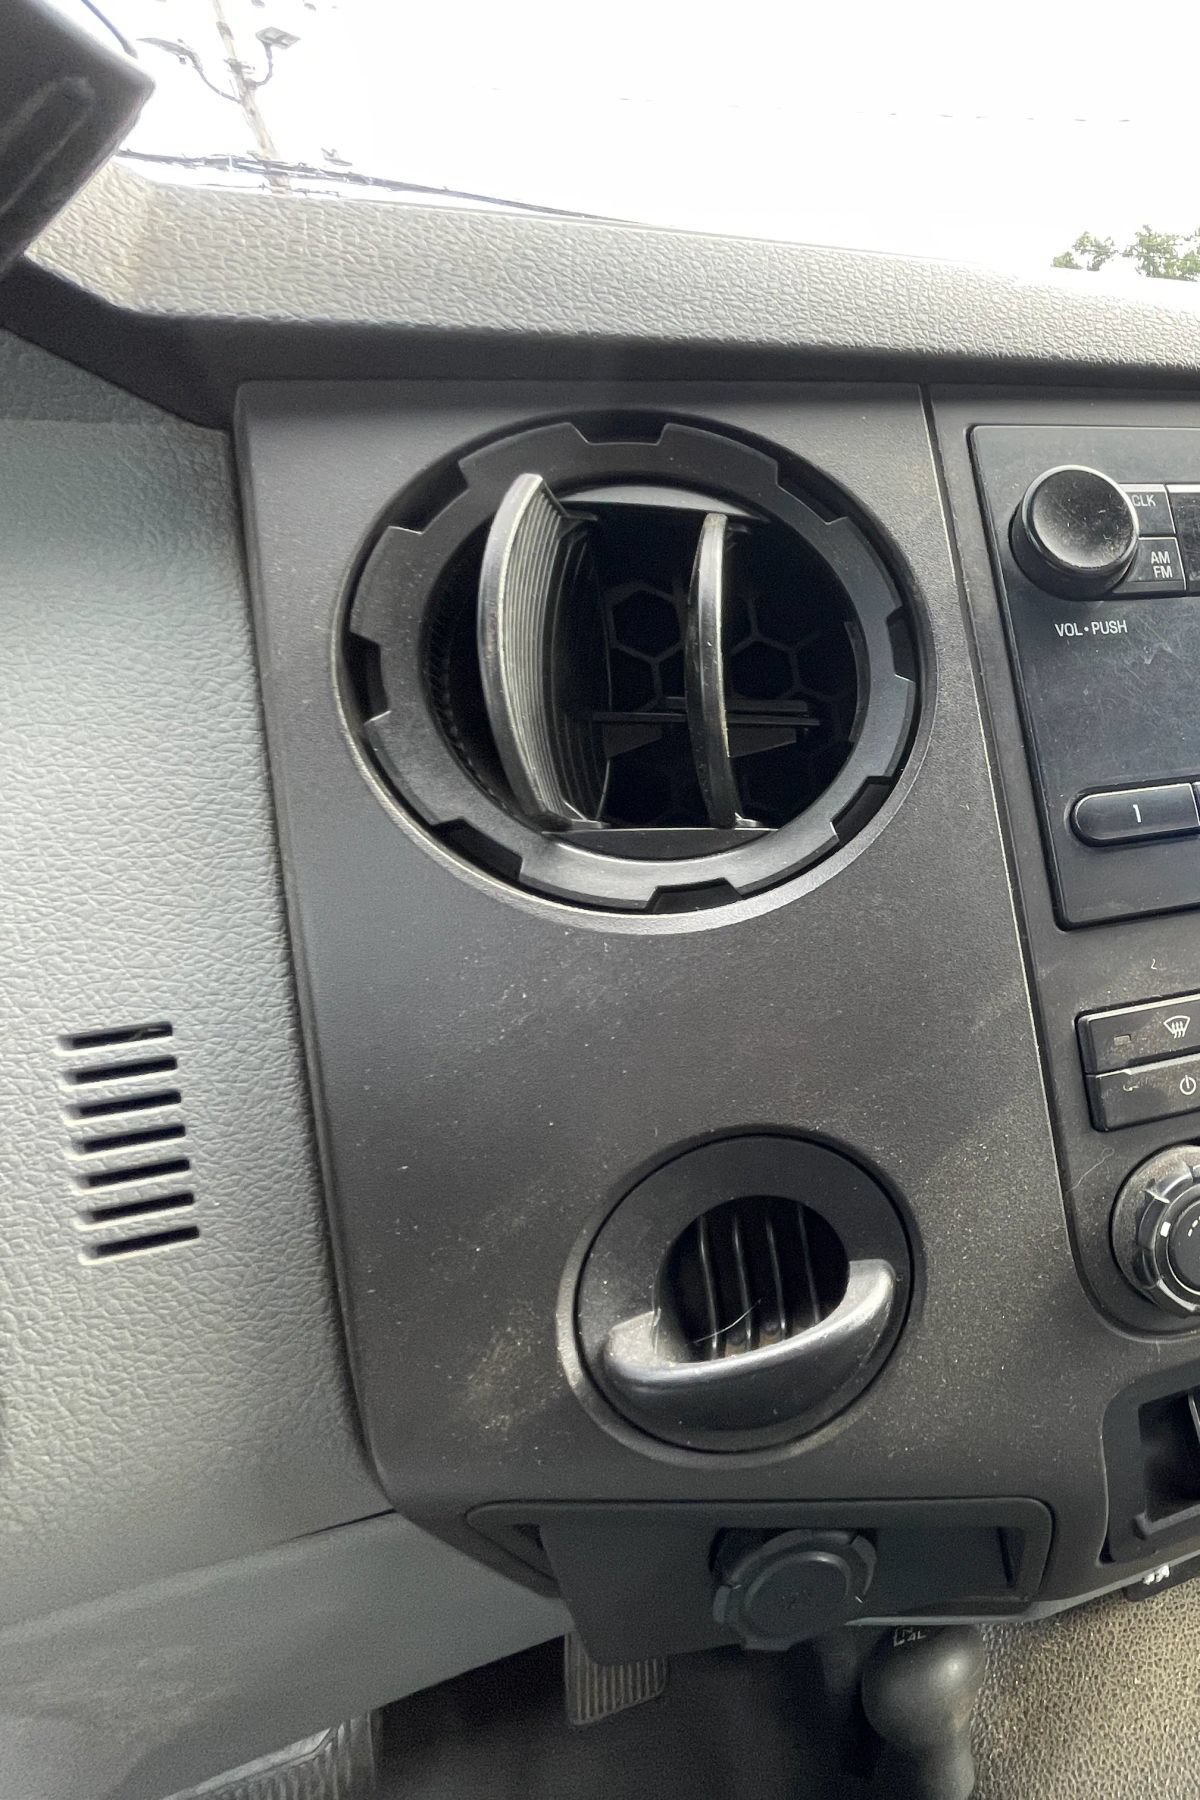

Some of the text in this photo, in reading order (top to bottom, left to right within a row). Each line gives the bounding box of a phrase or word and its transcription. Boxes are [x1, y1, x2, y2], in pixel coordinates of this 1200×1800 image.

[1131, 494, 1156, 507] CLK
[1151, 551, 1171, 564] AM
[1153, 565, 1173, 578] FM
[1132, 804, 1142, 823] 1
